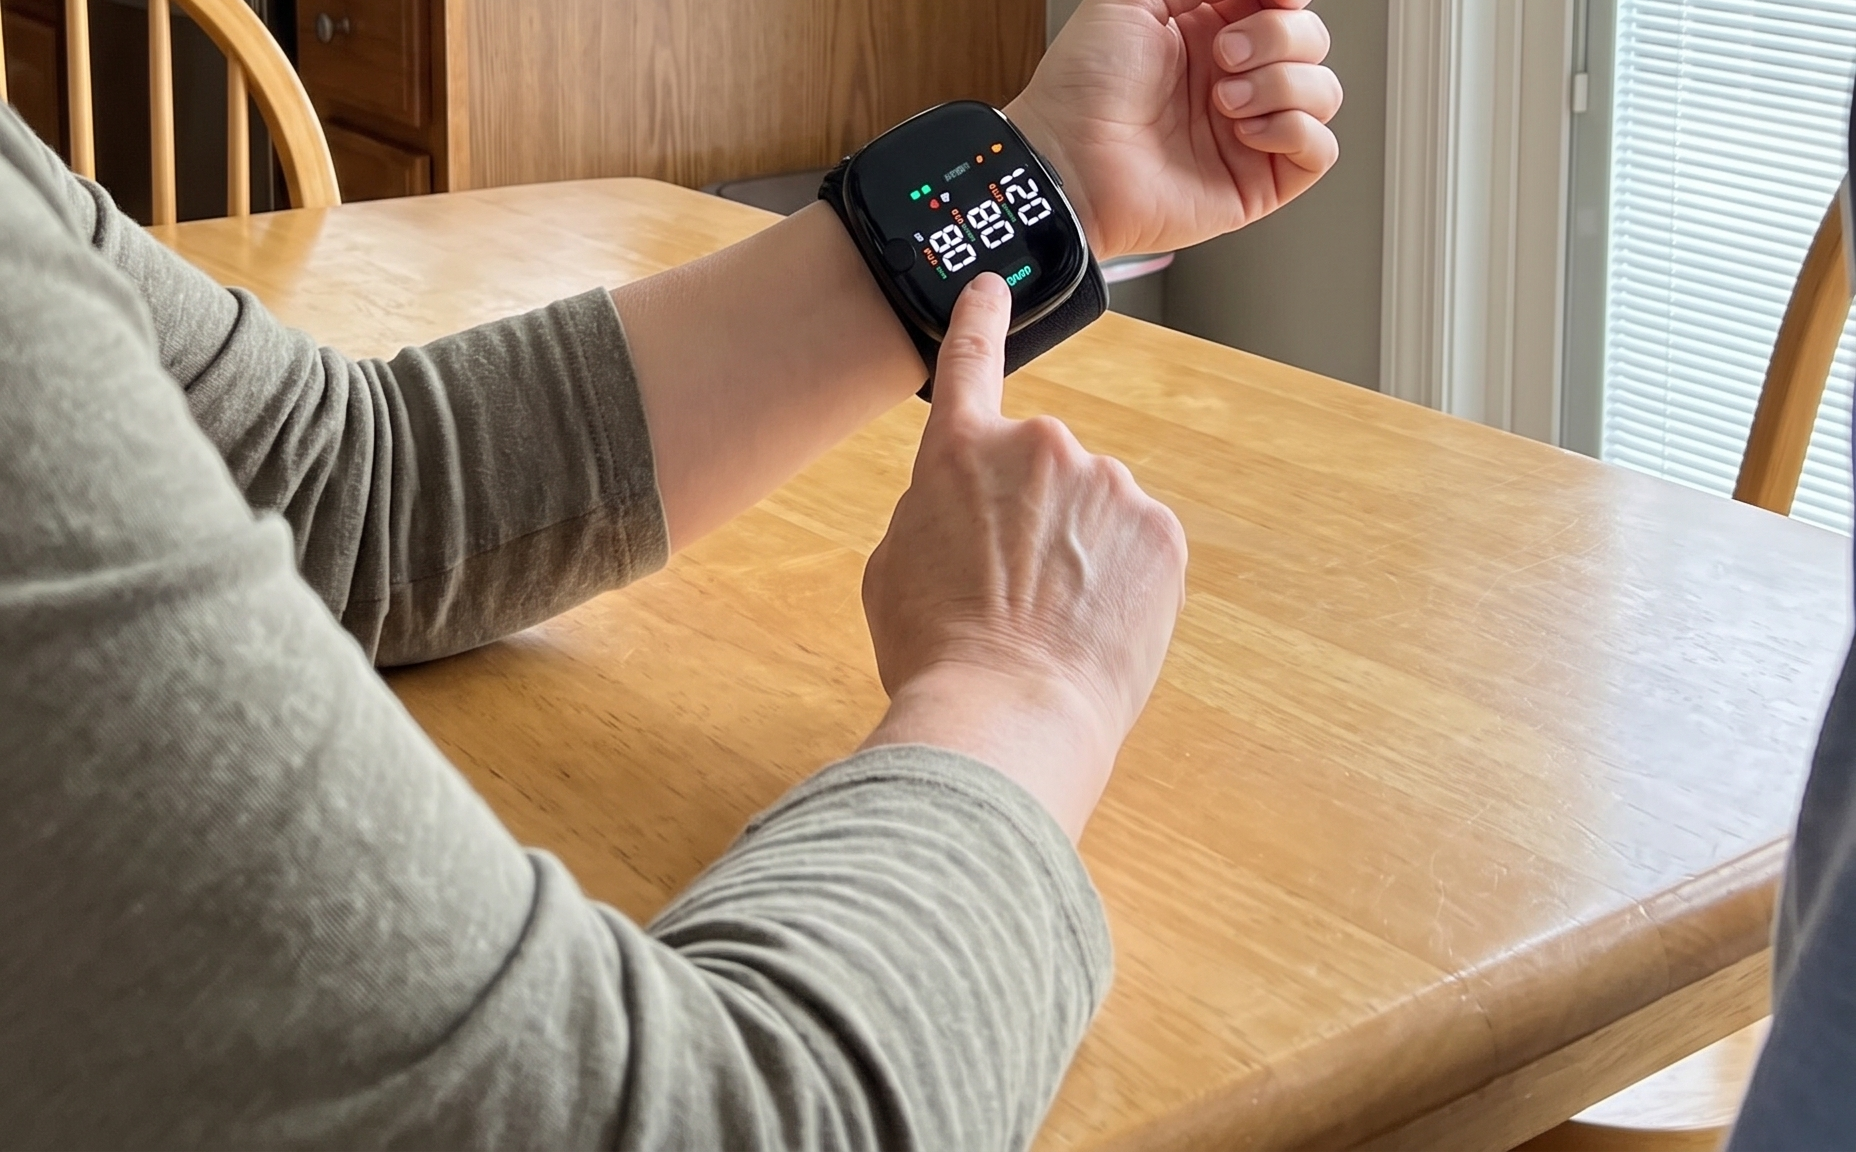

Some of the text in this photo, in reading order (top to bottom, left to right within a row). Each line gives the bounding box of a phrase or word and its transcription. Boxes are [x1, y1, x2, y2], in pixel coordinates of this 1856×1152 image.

[1000, 168, 1052, 226] 120
[929, 224, 977, 272] 80
[966, 199, 1015, 249] 80
